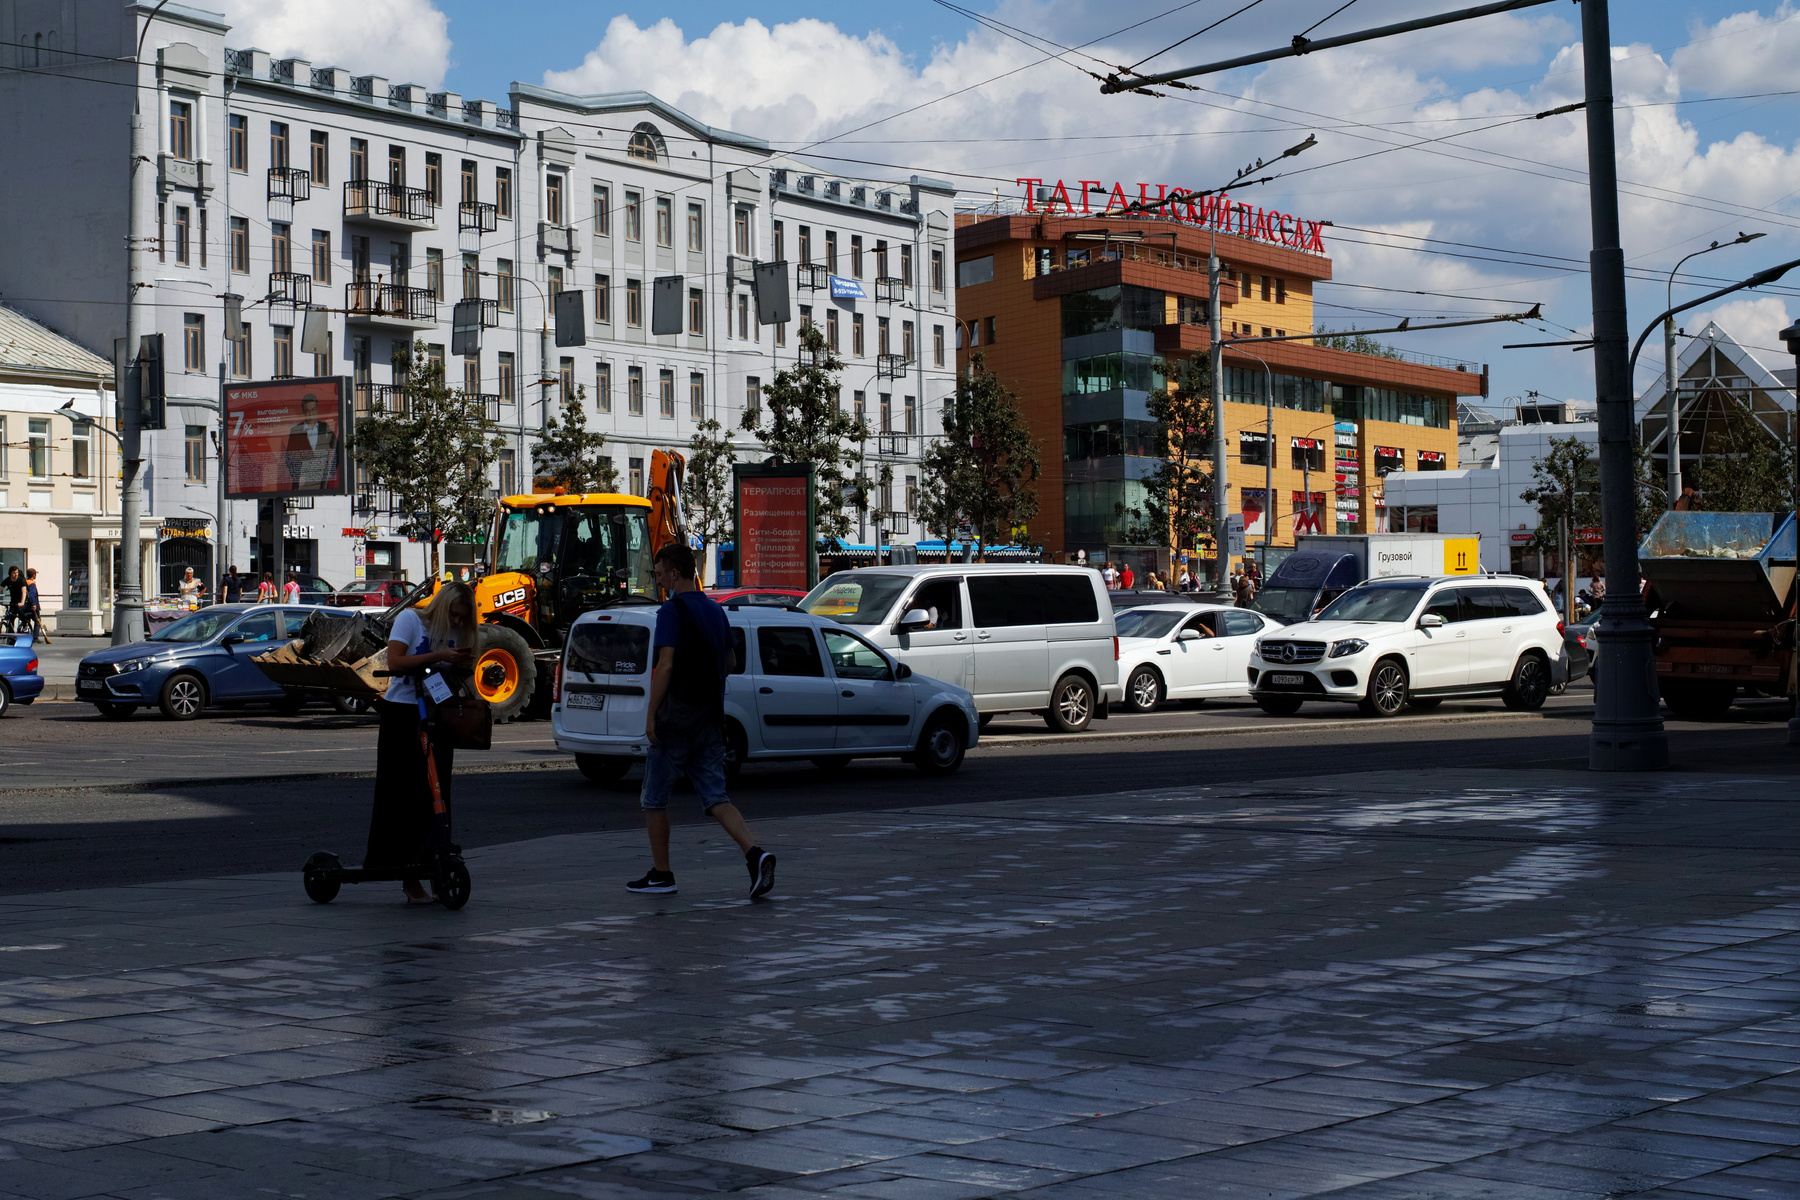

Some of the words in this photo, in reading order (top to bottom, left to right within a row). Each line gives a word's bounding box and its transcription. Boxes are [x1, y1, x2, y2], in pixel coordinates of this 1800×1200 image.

[1016, 178, 1232, 232] ТАГАНСКИЙ
[1237, 201, 1326, 253] ПАССАЖ
[241, 391, 258, 399] МКБ
[771, 458, 777, 468] 1
[743, 487, 806, 496] ТЕРРАПРОЕКТ
[743, 508, 795, 517] Размещение
[749, 528, 801, 538] Сити-бордах
[1575, 532, 1603, 541] БУРГЕ
[755, 544, 796, 554] Пилларах
[1378, 552, 1412, 563] Грузовой
[745, 560, 805, 570] Сити-формате
[494, 587, 526, 608] JCB
